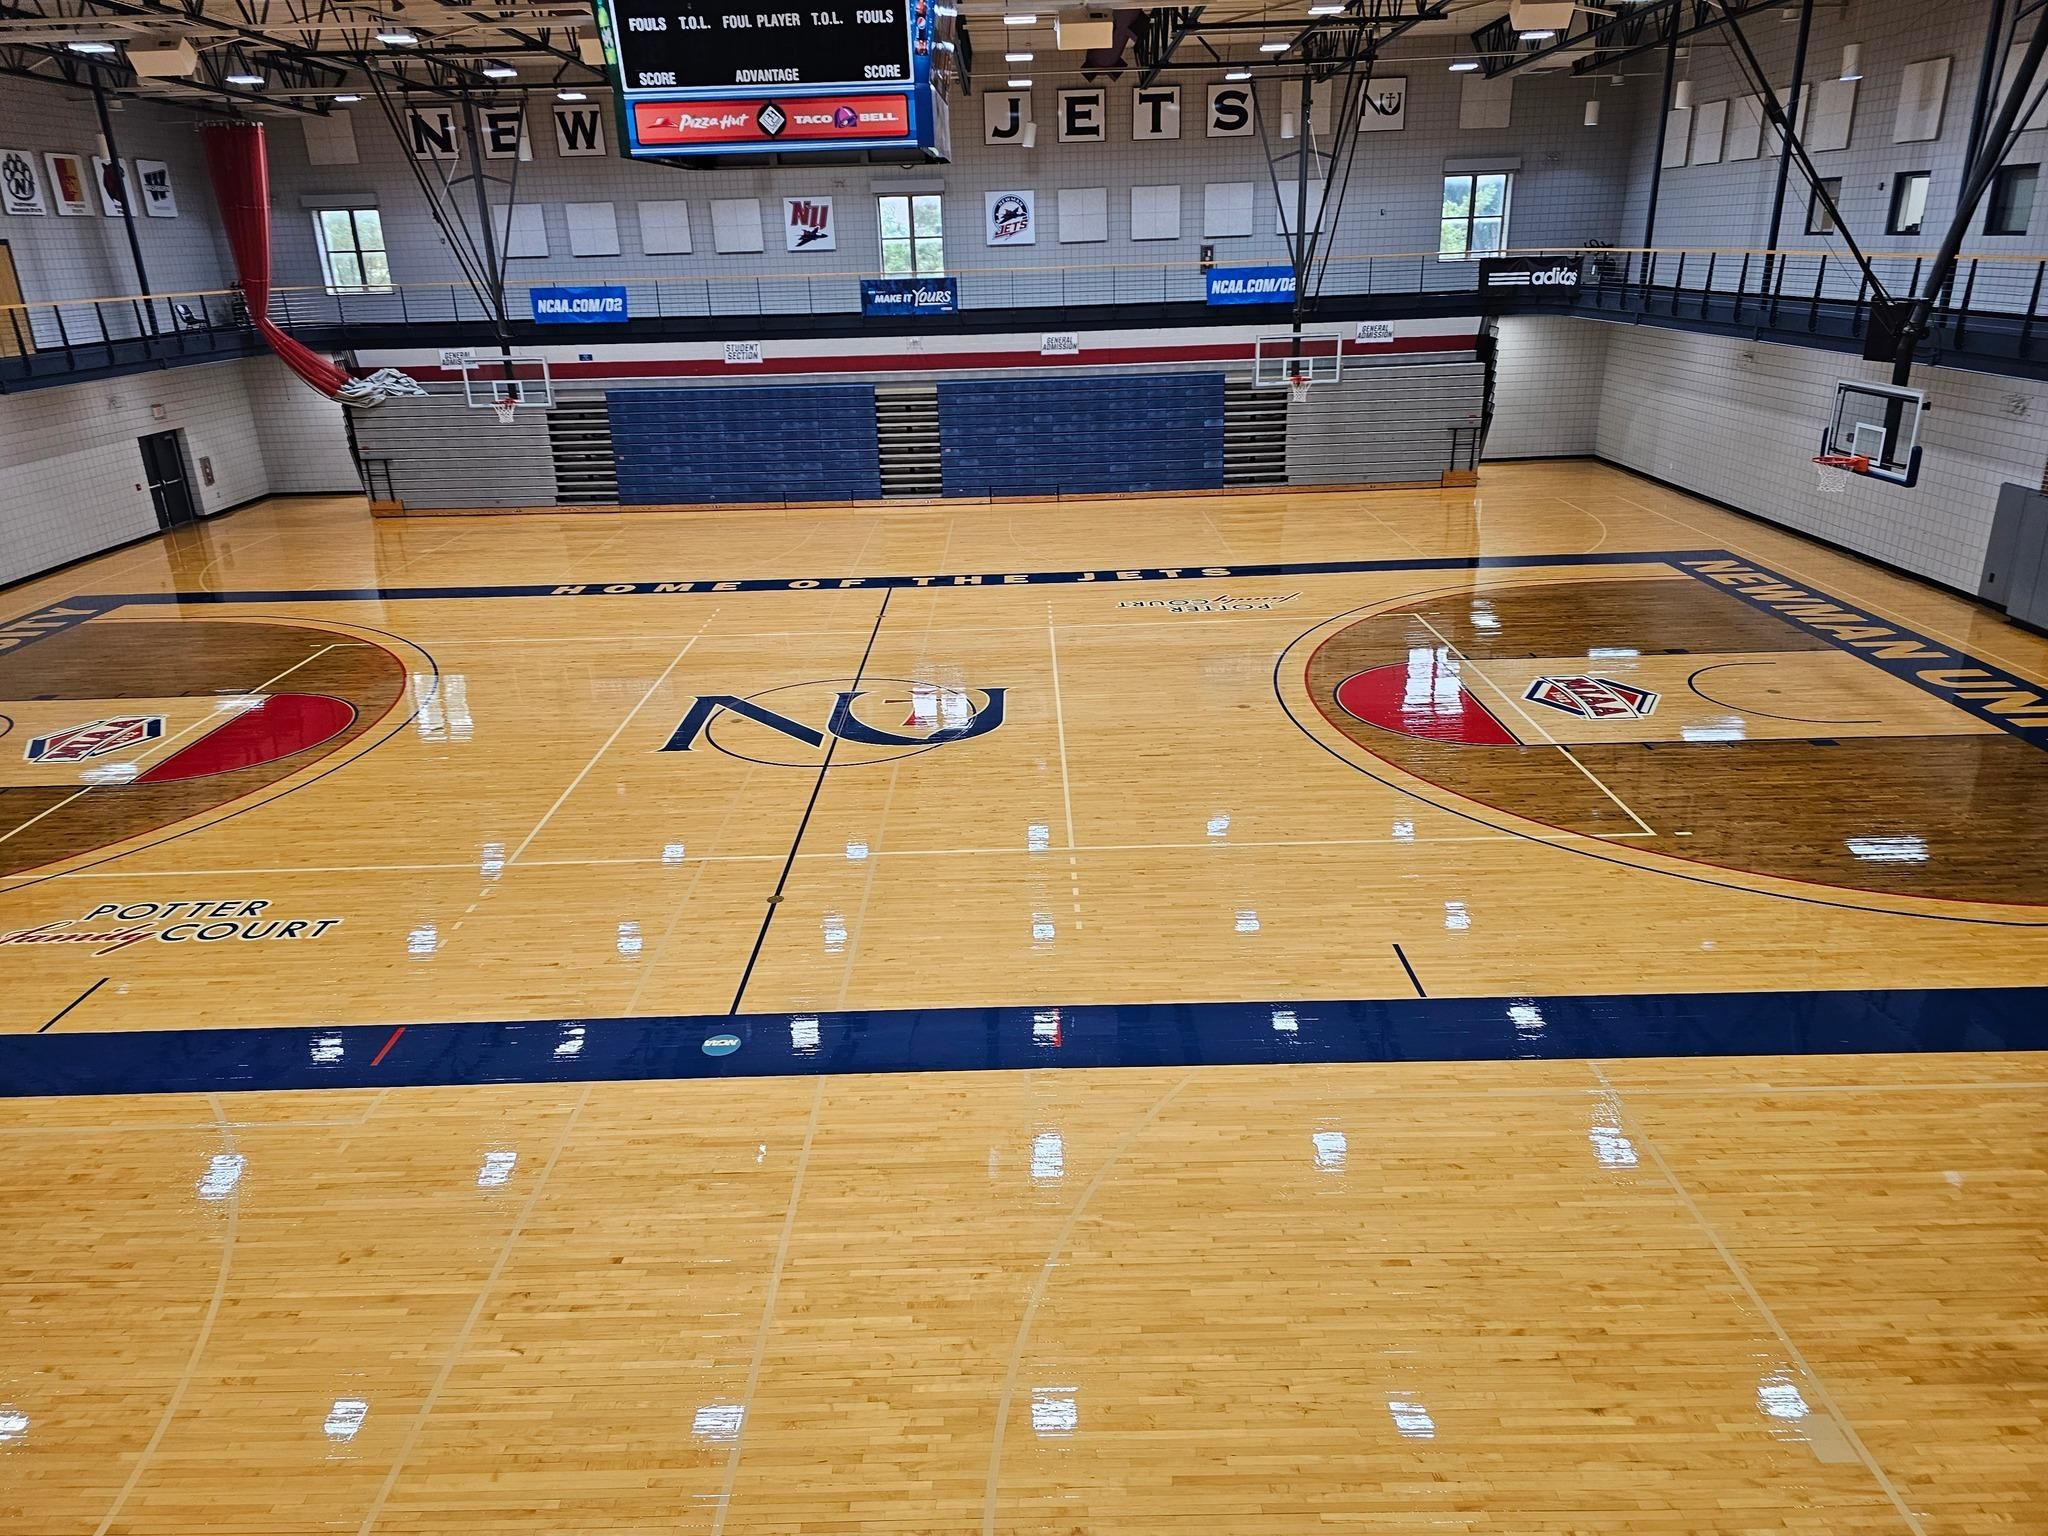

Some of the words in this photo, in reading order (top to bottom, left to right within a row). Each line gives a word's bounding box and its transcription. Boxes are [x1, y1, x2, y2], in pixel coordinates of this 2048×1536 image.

[628, 17, 667, 32] FOULS
[678, 16, 711, 30] T.O.L.
[722, 15, 752, 29] FOUL
[756, 13, 801, 28] PLAYER
[811, 12, 844, 26] T.O.L.
[856, 10, 894, 24] FOULS
[639, 72, 677, 86] SCORE
[735, 68, 799, 82] ADVANTAGE
[864, 64, 901, 79] SCORE
[678, 114, 719, 132] Pizza
[719, 113, 750, 130] Hut
[794, 115, 833, 124] TACO
[859, 112, 898, 122] BELL
[788, 200, 829, 230] NU
[996, 219, 1029, 236] JETS
[1531, 266, 1577, 287] adidas
[1211, 276, 1296, 295] NCAA.COM/D2
[537, 297, 624, 314] NCAA.COM/D2
[874, 294, 903, 303] MAKE
[903, 293, 913, 303] IT
[1357, 331, 1394, 340] ADMISSION
[1361, 324, 1390, 333] GENERAL
[725, 343, 759, 353] STUDENT
[1042, 342, 1078, 351] ADMISSION
[1046, 336, 1073, 344] GENERAL
[727, 351, 759, 361] SECTION
[550, 582, 743, 595] HOME
[787, 579, 866, 589] OF
[912, 575, 1030, 586] THE
[1076, 567, 1232, 581] JETS
[1117, 599, 1209, 609] COURT
[1170, 602, 1273, 613] POTTER
[1679, 559, 1950, 660] NEWMAN
[655, 687, 1009, 753] NU
[83, 899, 270, 922] POTTER
[160, 918, 341, 944] COURT
